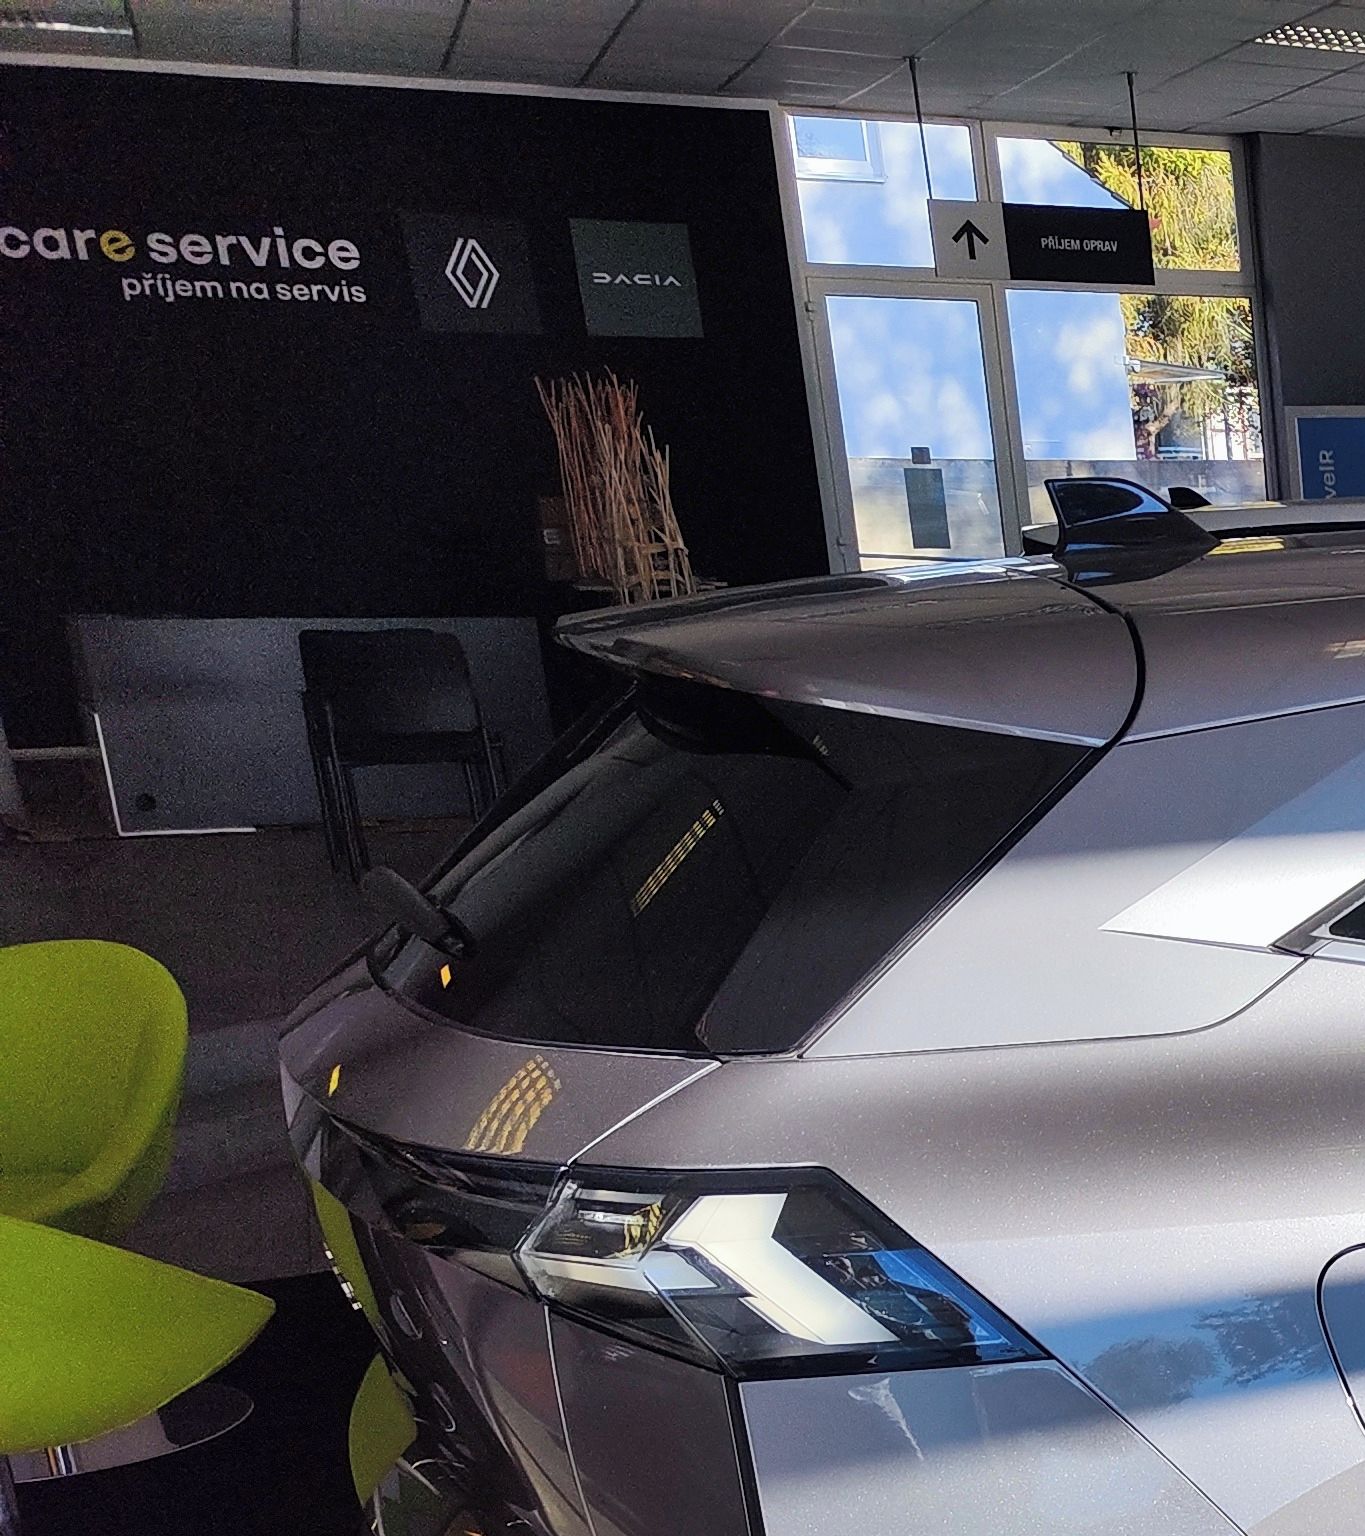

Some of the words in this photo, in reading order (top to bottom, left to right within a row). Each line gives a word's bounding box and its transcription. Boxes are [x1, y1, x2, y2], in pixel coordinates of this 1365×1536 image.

[0, 226, 136, 262] care
[146, 226, 361, 270] service
[1040, 235, 1080, 251] PŘÍJEM
[1082, 239, 1118, 252] OPRAV
[121, 273, 224, 302] příjem
[229, 279, 269, 300] na
[276, 279, 367, 303] servis
[591, 272, 682, 287] DACIA
